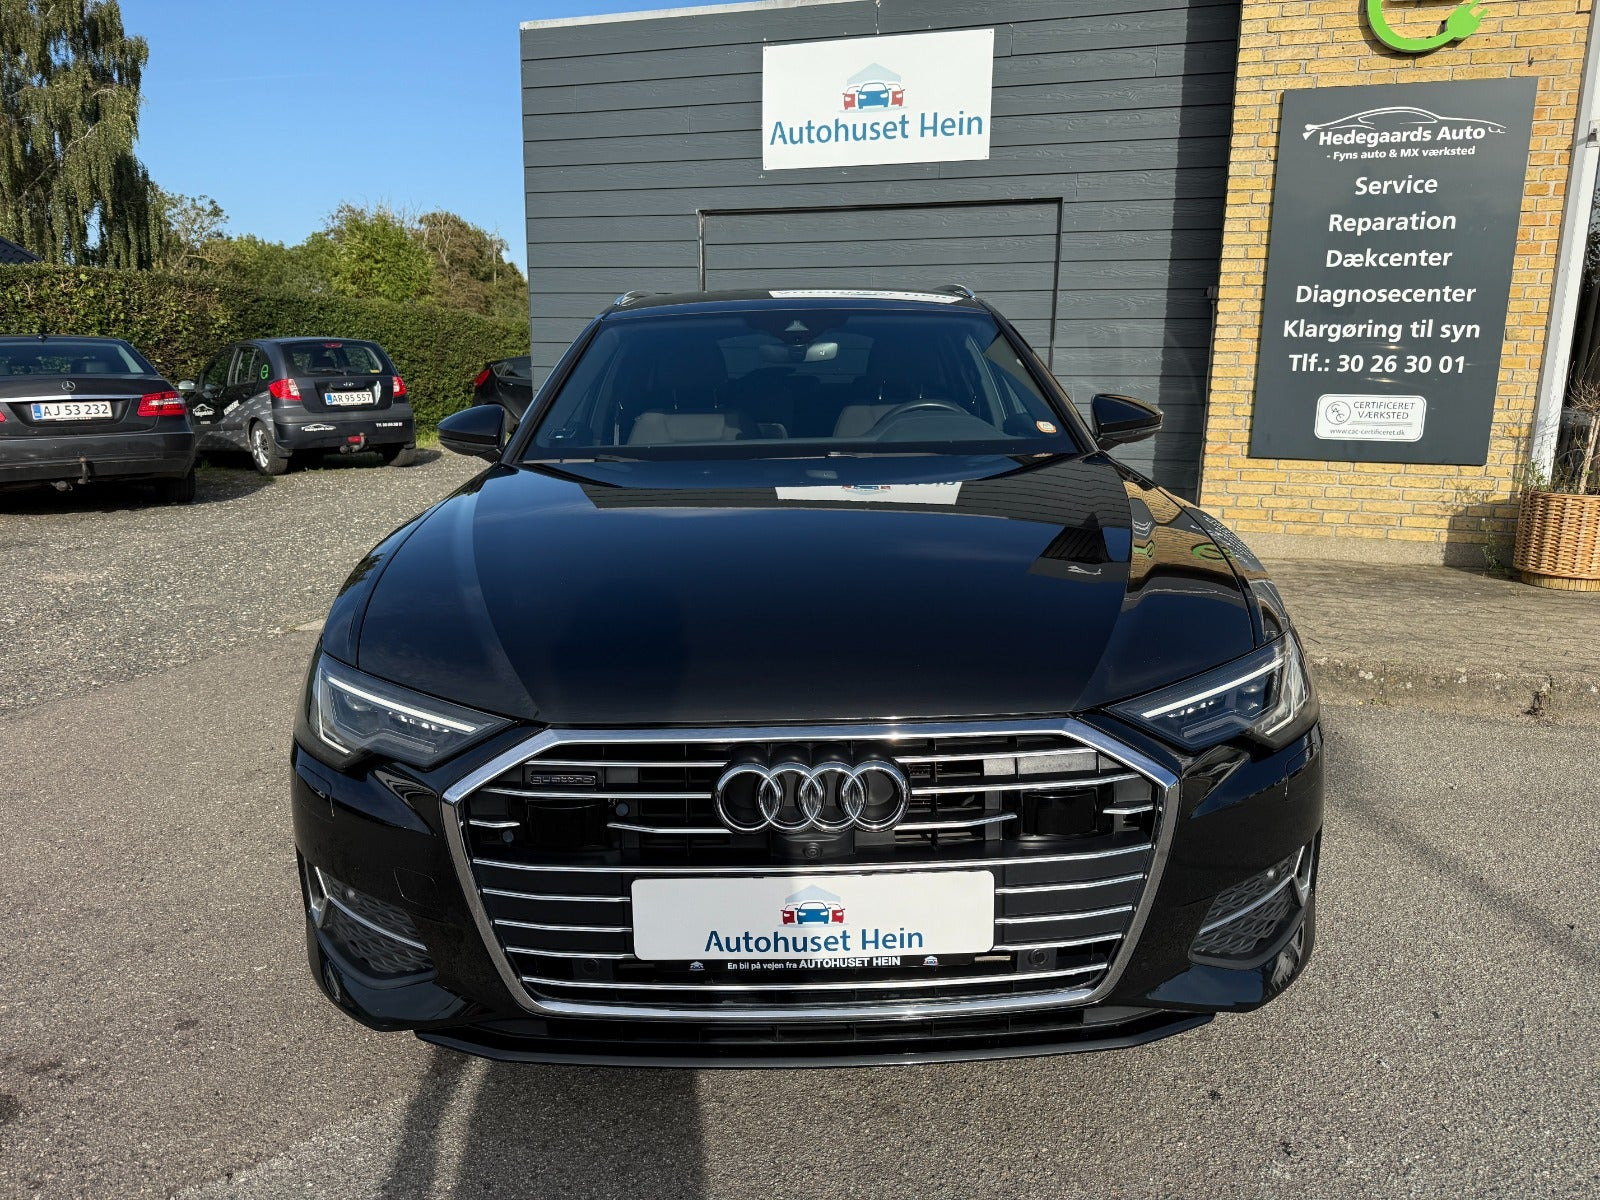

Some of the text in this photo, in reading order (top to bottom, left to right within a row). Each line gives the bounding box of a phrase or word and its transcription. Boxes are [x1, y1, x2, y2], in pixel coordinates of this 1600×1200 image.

[769, 111, 983, 146] Autohuset Hein
[1318, 125, 1486, 148] Hedegaards Auto
[1333, 151, 1358, 161] Fyns
[1360, 149, 1387, 159] auto
[1388, 149, 1398, 158] &
[1400, 148, 1420, 157] MX
[1421, 146, 1476, 157] værksted
[1354, 174, 1439, 196] Service
[1328, 210, 1457, 236] Reparation
[1325, 248, 1453, 268] Dækcenter
[1295, 285, 1477, 308] Diagnosecenter
[1283, 319, 1481, 343] Klargøring til syn
[1288, 353, 1466, 374] Tlf.: 30 26 30 01
[332, 393, 371, 403] AR 95 557
[1353, 401, 1416, 410] CERTIFICERET
[43, 403, 109, 416] AJ 53 232
[1358, 411, 1409, 420] VÆRKSTED
[704, 927, 923, 953] Autohuset Hein
[727, 956, 901, 971] En bil på vejen fra AUTOHUSET HEIN
